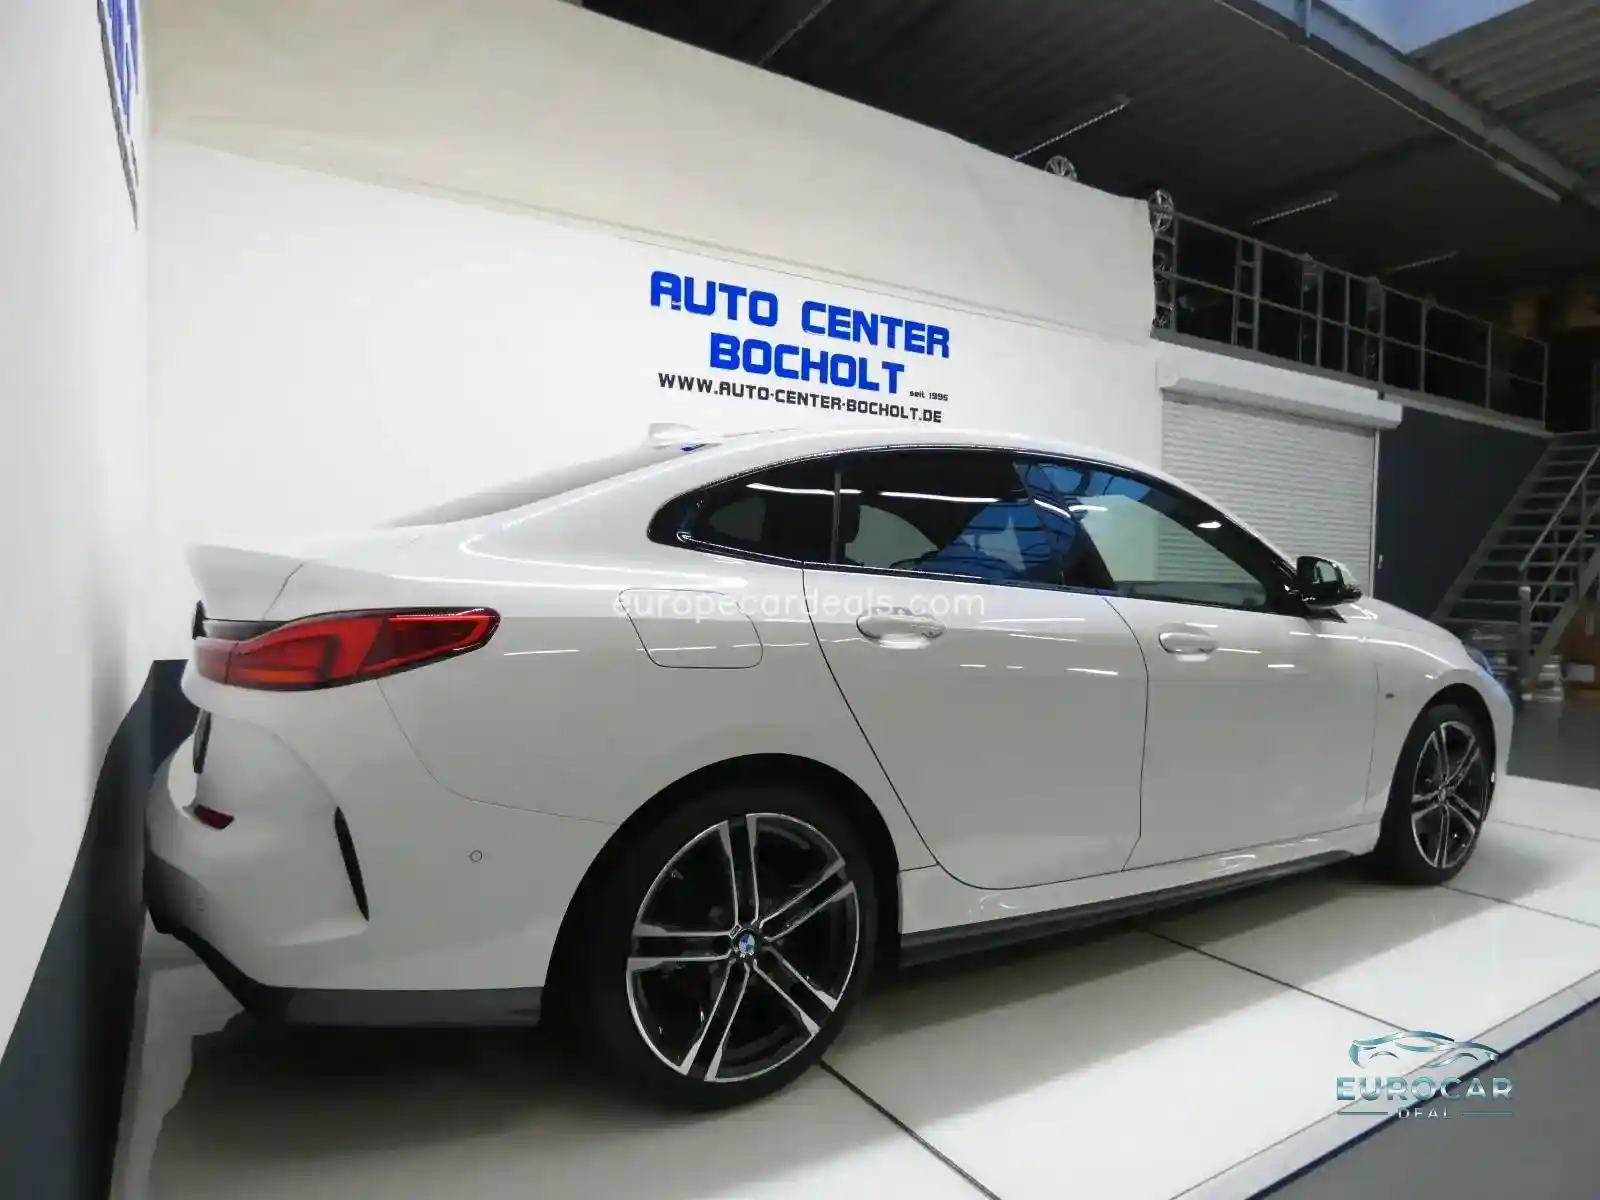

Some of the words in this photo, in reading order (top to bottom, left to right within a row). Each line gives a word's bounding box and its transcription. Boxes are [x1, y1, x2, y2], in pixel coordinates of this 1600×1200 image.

[650, 270, 778, 327] AUTO
[801, 300, 949, 358] CENTER
[710, 332, 905, 394] BOCHOLT
[909, 389, 926, 399] seit
[928, 392, 949, 402] 1995
